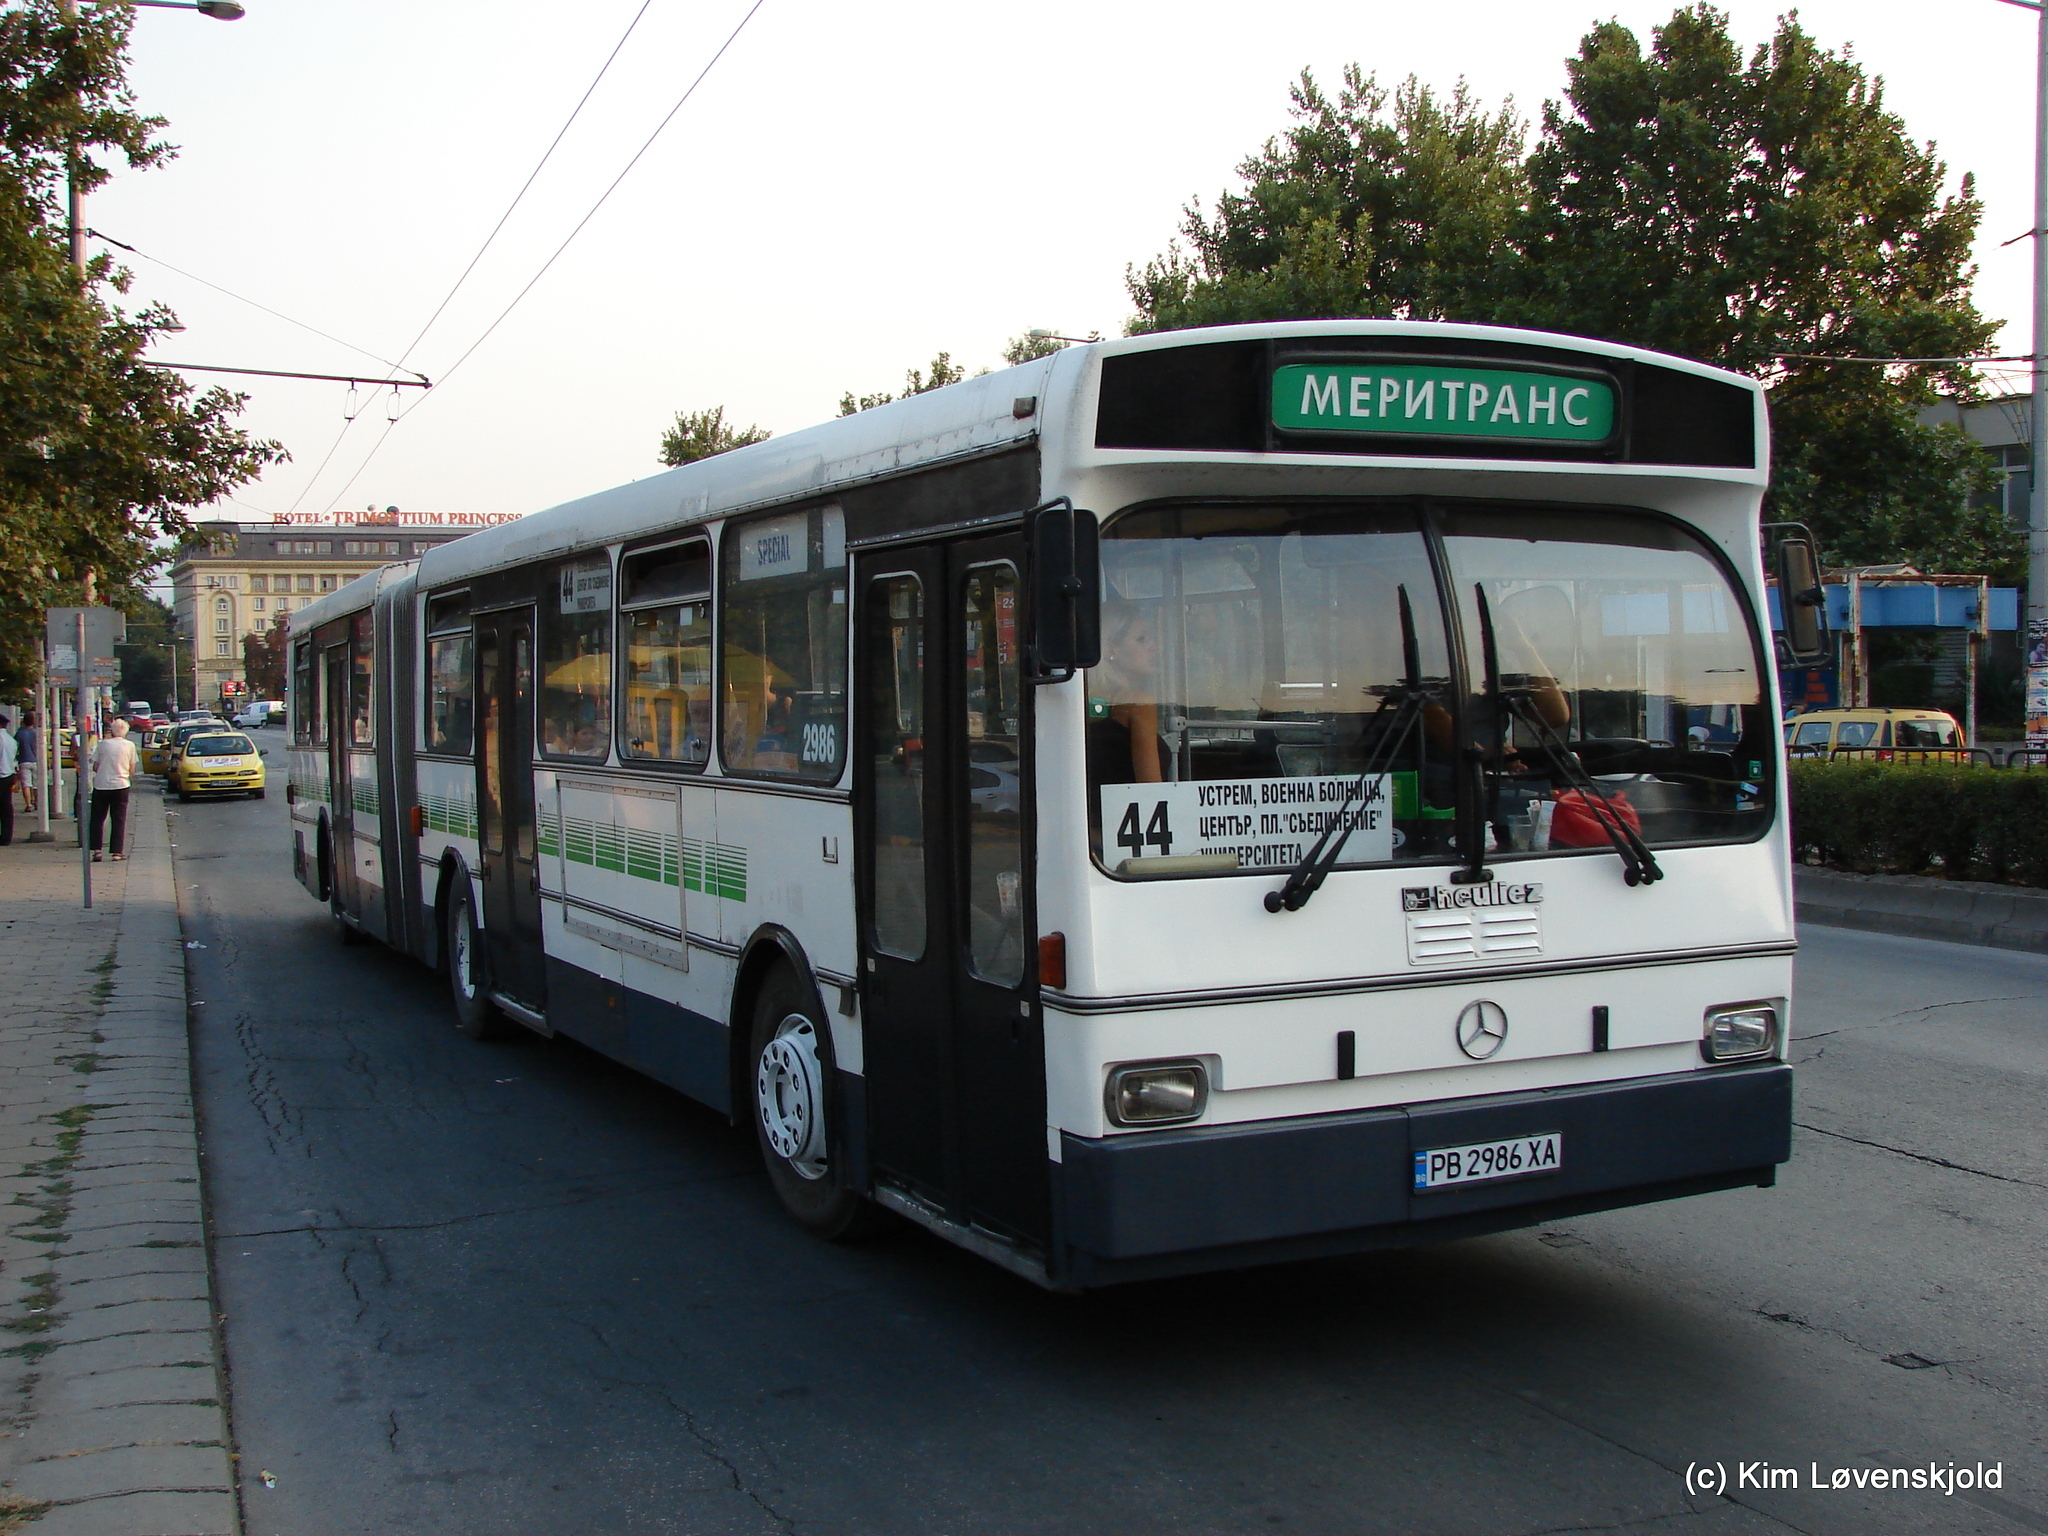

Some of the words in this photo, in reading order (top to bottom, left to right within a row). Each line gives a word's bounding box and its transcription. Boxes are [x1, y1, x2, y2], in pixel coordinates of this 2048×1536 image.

[1300, 373, 1590, 426] МЕРИТРАНС
[273, 512, 323, 525] HOTEL
[333, 511, 446, 525] TRIMONTIUM
[562, 570, 574, 603] 44
[803, 723, 836, 764] 2986
[1198, 784, 1258, 809] УСТРЕМ,
[1262, 782, 1316, 804] ВОЕННА
[1319, 779, 1385, 804] БОЛНИЦА,
[1117, 800, 1173, 858] 44
[1199, 815, 1257, 841] ЦЕНТЪР,
[1434, 881, 1544, 910] heuliez
[1430, 1151, 1462, 1182] PB
[1466, 1143, 1522, 1177] 2986
[1528, 1138, 1556, 1168] XA
